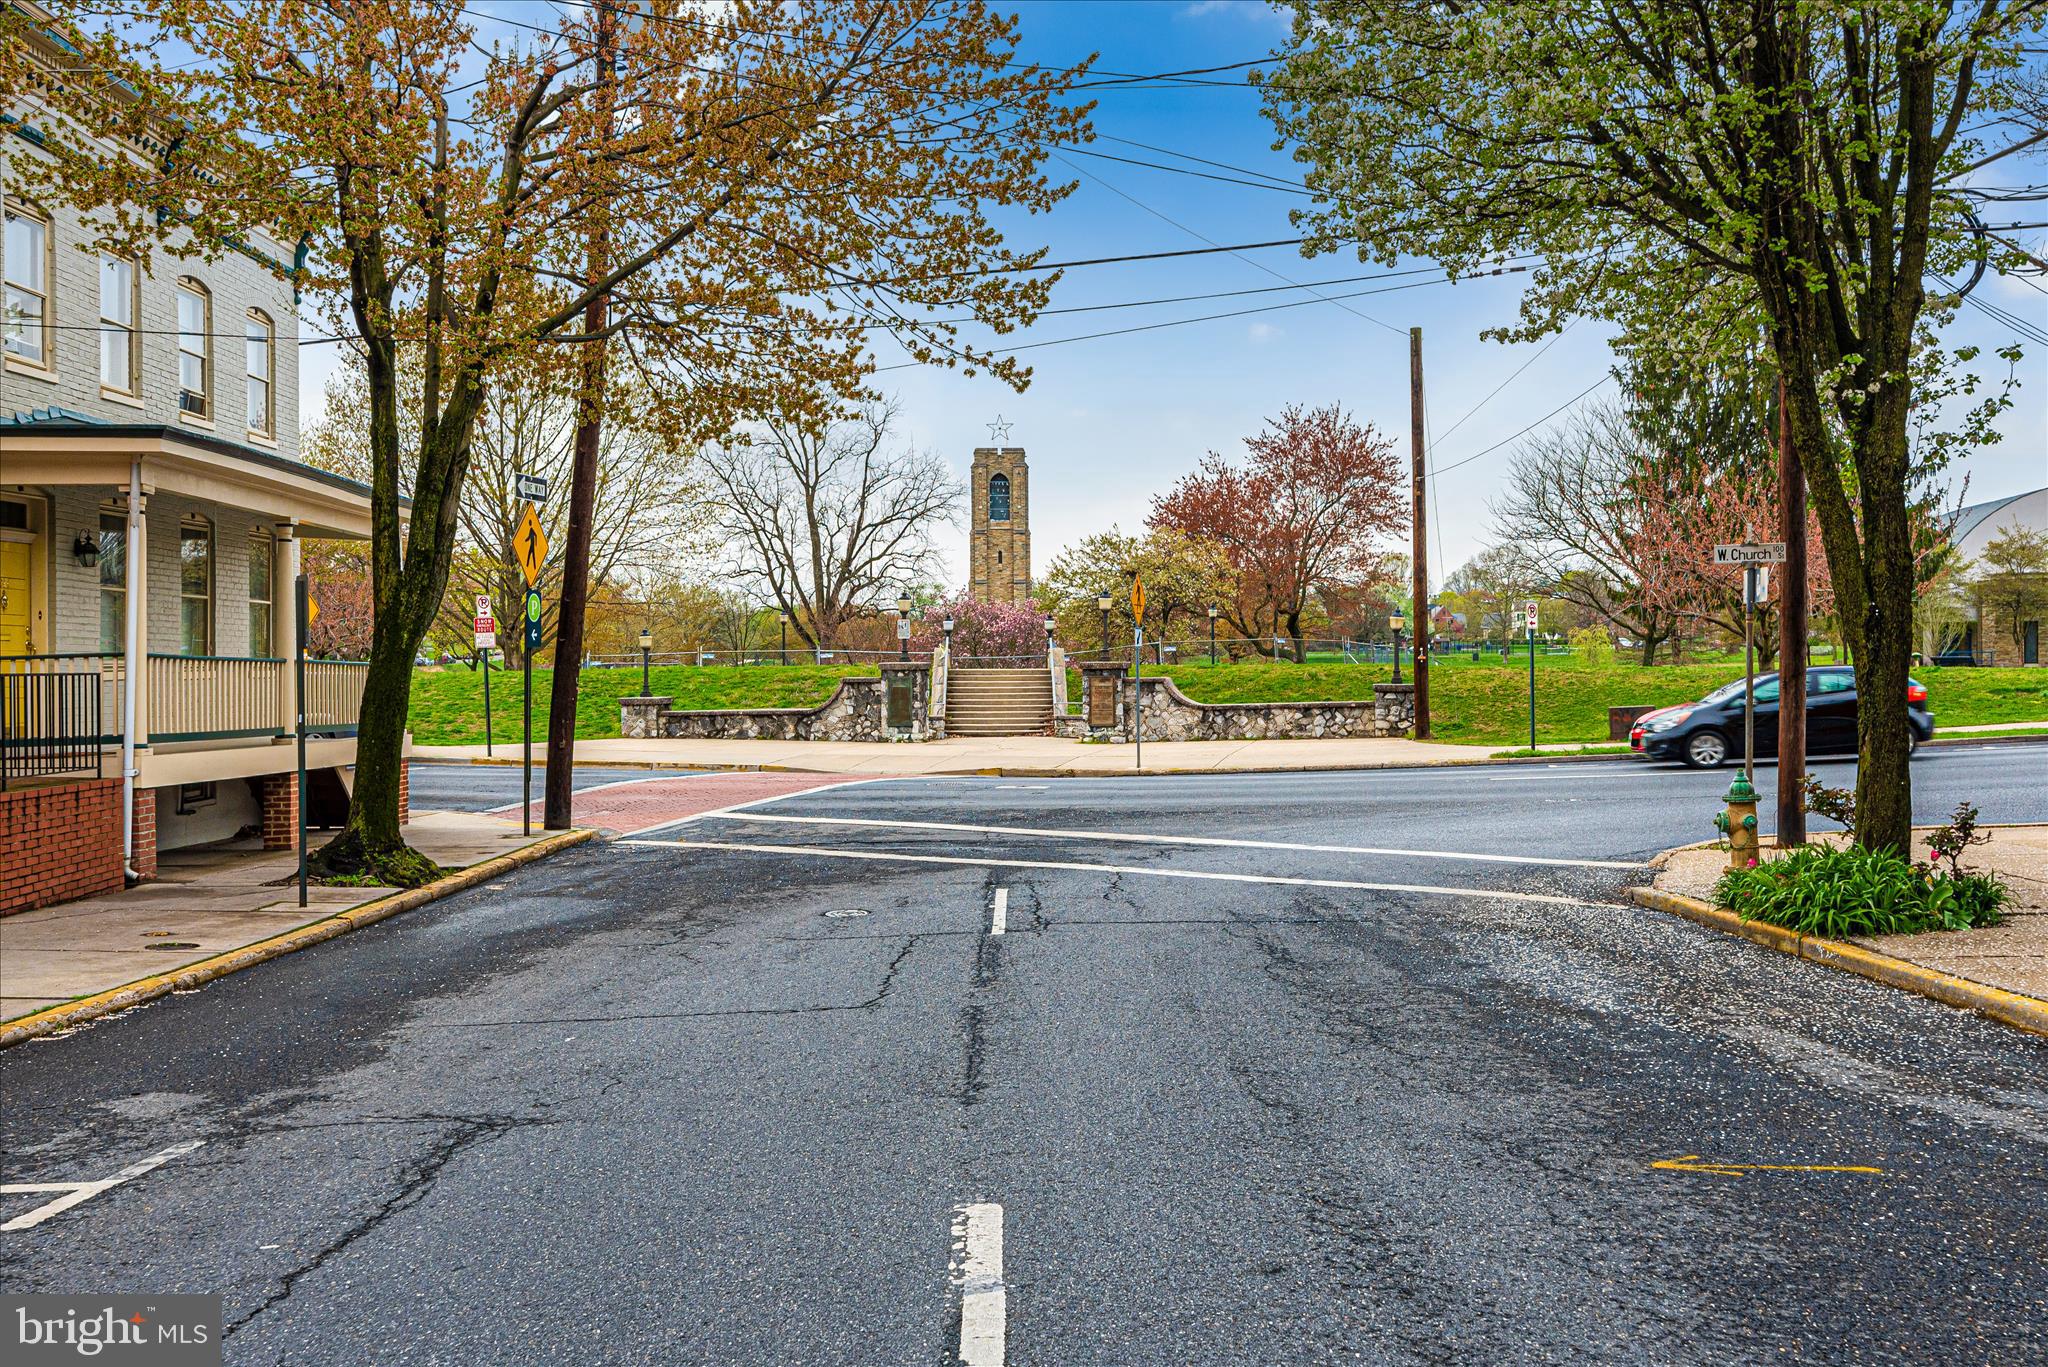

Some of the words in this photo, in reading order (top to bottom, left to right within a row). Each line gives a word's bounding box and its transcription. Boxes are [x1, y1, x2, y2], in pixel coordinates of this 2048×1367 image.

[524, 482, 532, 493] ONE
[534, 485, 544, 494] WAY
[1717, 549, 1729, 561] W.
[1731, 548, 1771, 560] Church
